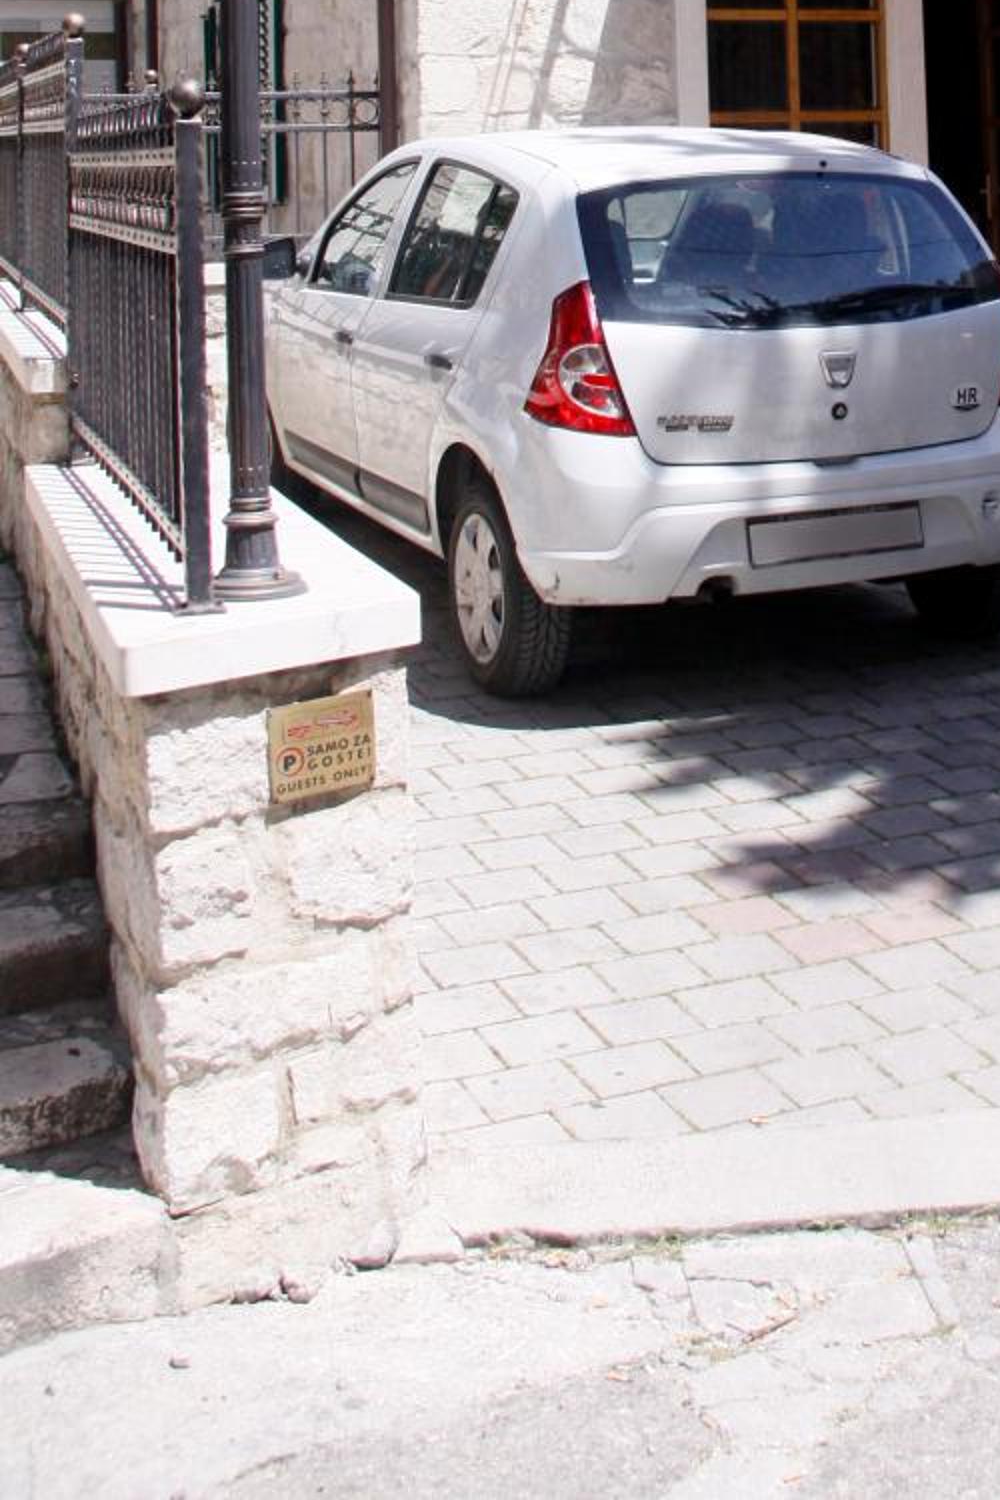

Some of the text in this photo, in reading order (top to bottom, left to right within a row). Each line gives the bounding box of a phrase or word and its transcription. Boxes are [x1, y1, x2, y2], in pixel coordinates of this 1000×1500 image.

[957, 387, 977, 404] HR
[306, 733, 371, 757] SAMO ZA
[283, 754, 297, 772] P
[276, 775, 326, 795] GUESTS
